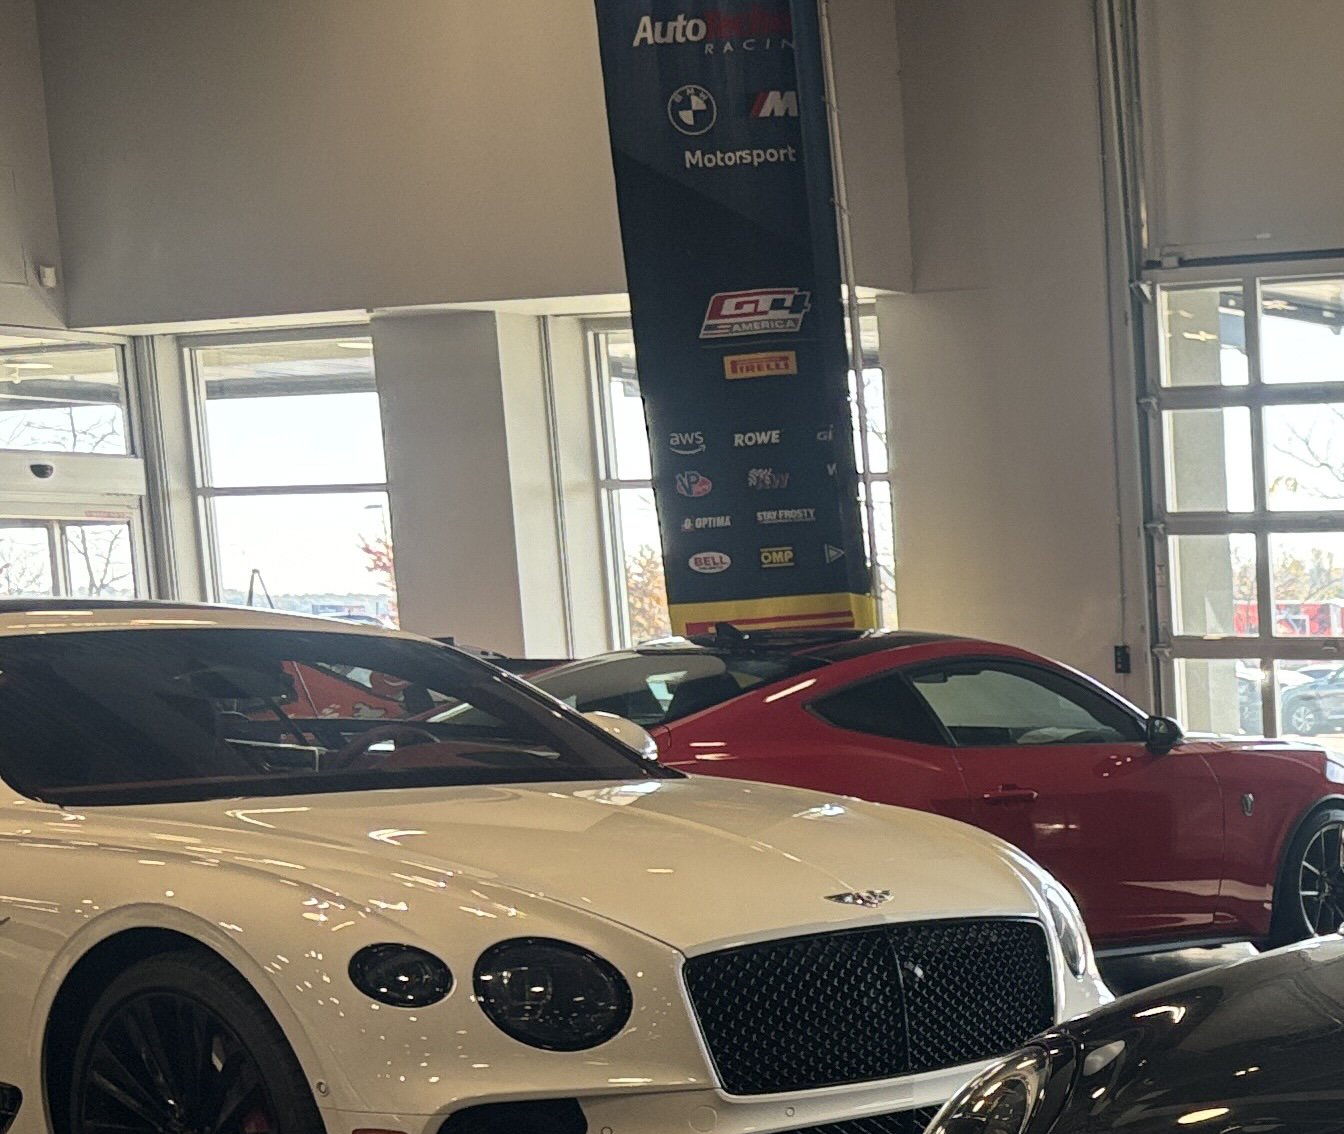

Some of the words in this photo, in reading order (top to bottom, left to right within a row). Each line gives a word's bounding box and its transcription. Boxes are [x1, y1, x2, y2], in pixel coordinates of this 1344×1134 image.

[684, 145, 797, 168] Motorsport
[732, 319, 796, 332] AMERICA
[730, 356, 790, 374] PIRELLI
[669, 431, 705, 446] aws
[733, 430, 781, 447] ROWE
[756, 509, 777, 521] STAY
[778, 508, 816, 519] FROSTY
[694, 515, 731, 529] OPTIMA
[693, 555, 728, 568] BELL
[760, 551, 794, 565] OMP
